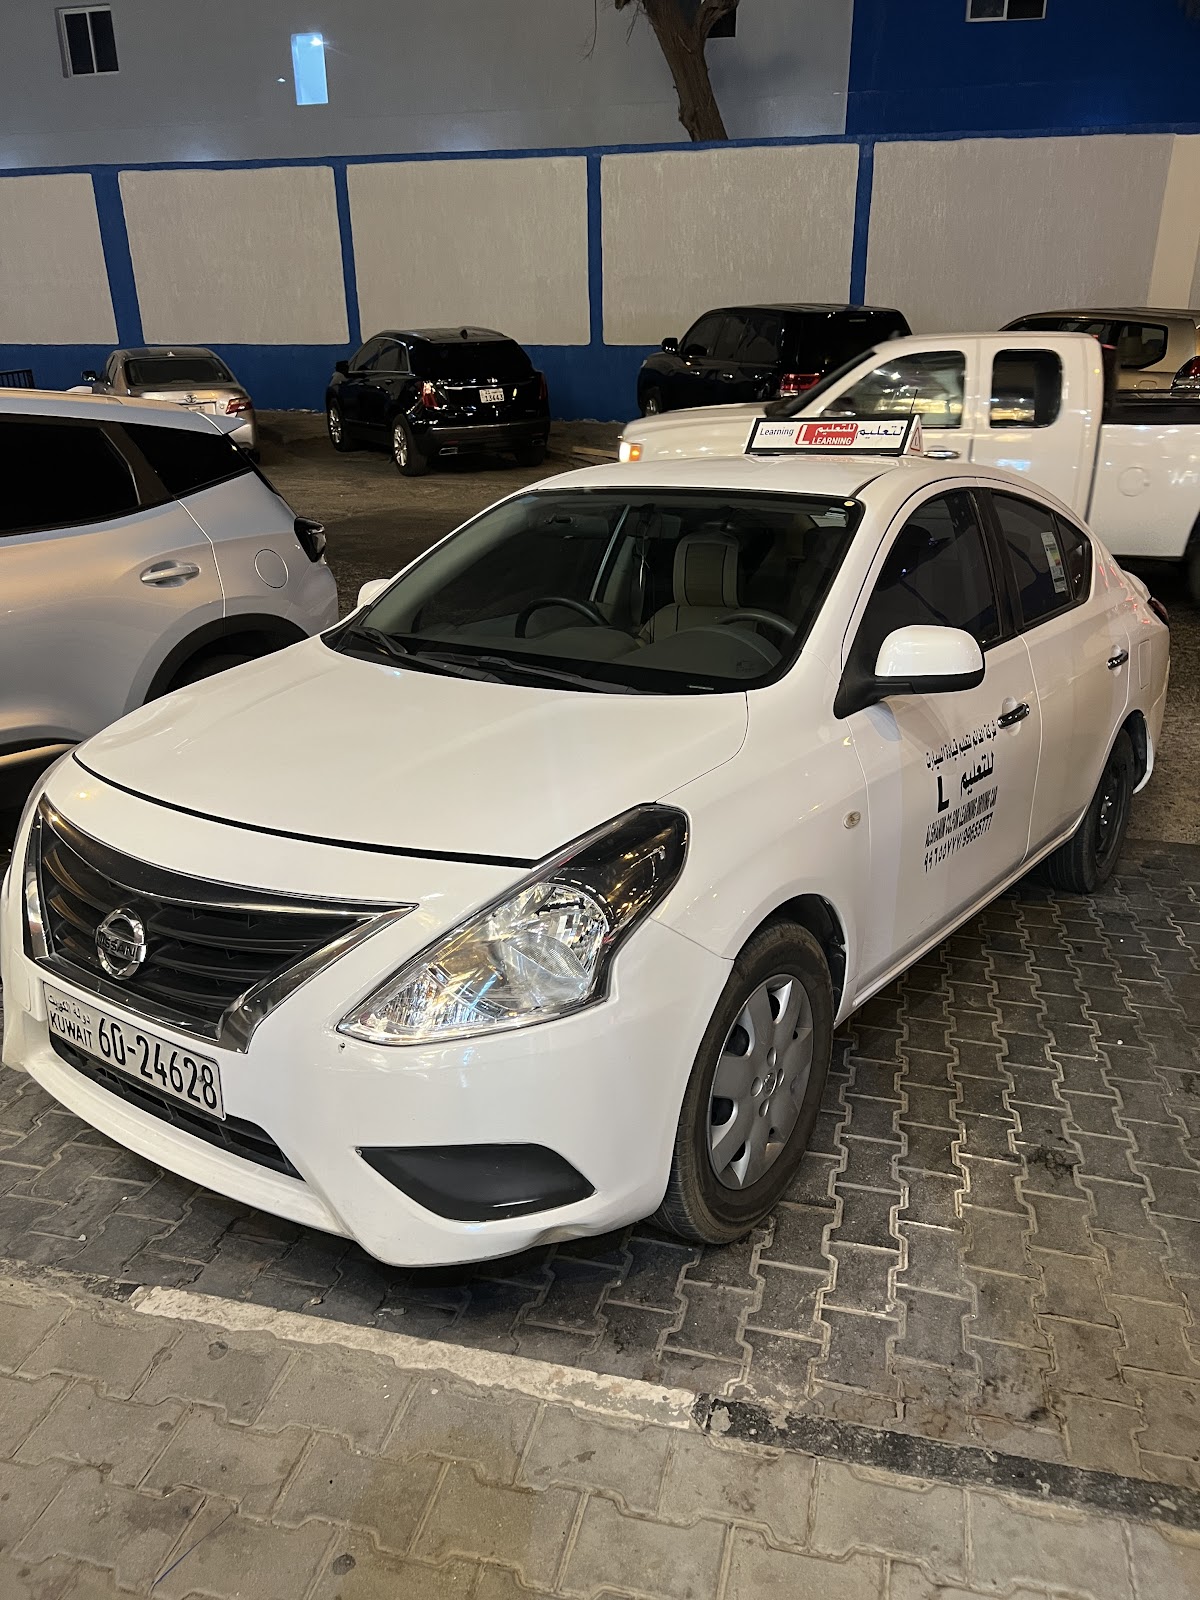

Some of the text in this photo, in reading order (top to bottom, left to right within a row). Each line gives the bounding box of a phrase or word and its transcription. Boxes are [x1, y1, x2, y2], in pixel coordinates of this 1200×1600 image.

[759, 427, 794, 437] Learning
[798, 425, 810, 444] L
[811, 436, 852, 445] LEARNING
[814, 423, 856, 437] للتعليم
[960, 749, 994, 799] للتعليم
[937, 775, 949, 813] L
[97, 930, 136, 957] NISSAN
[48, 995, 91, 1025] دولة الكويت
[50, 1011, 93, 1048] KUWAIT
[98, 1017, 217, 1109] 60-24628
